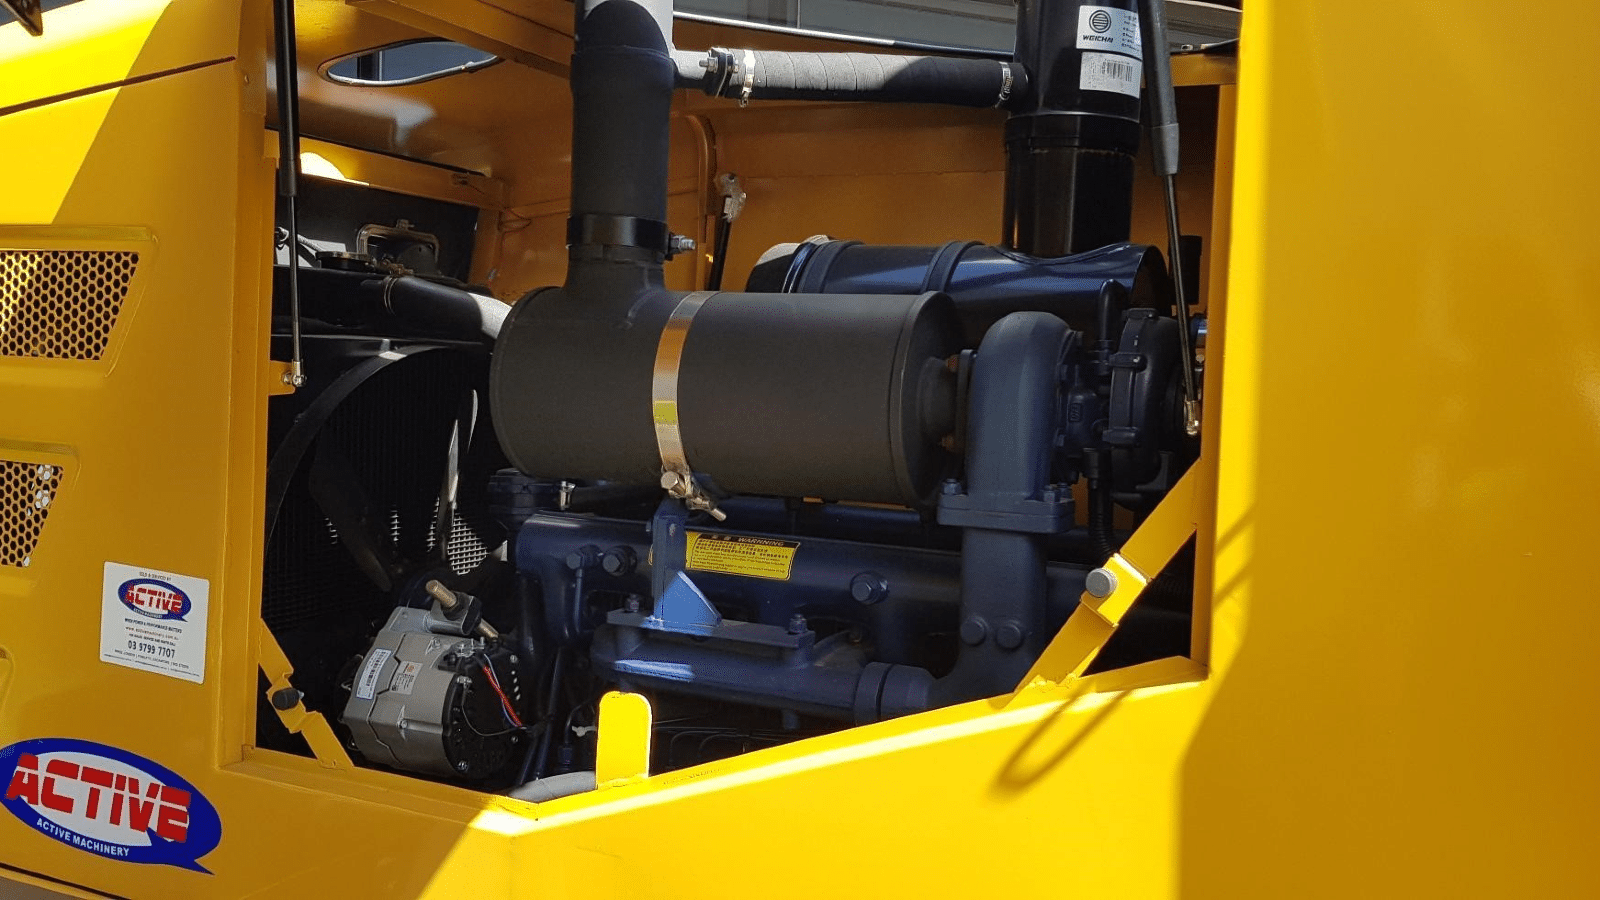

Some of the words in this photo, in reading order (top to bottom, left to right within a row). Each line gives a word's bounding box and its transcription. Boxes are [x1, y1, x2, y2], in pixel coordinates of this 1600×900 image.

[126, 584, 183, 613] ACTIVE
[127, 640, 137, 650] 03
[138, 643, 155, 654] 9799
[158, 646, 176, 658] 7707
[4, 752, 192, 843] ACTIVE
[36, 817, 71, 841] ACTIVE
[72, 835, 130, 857] MACHINERY
